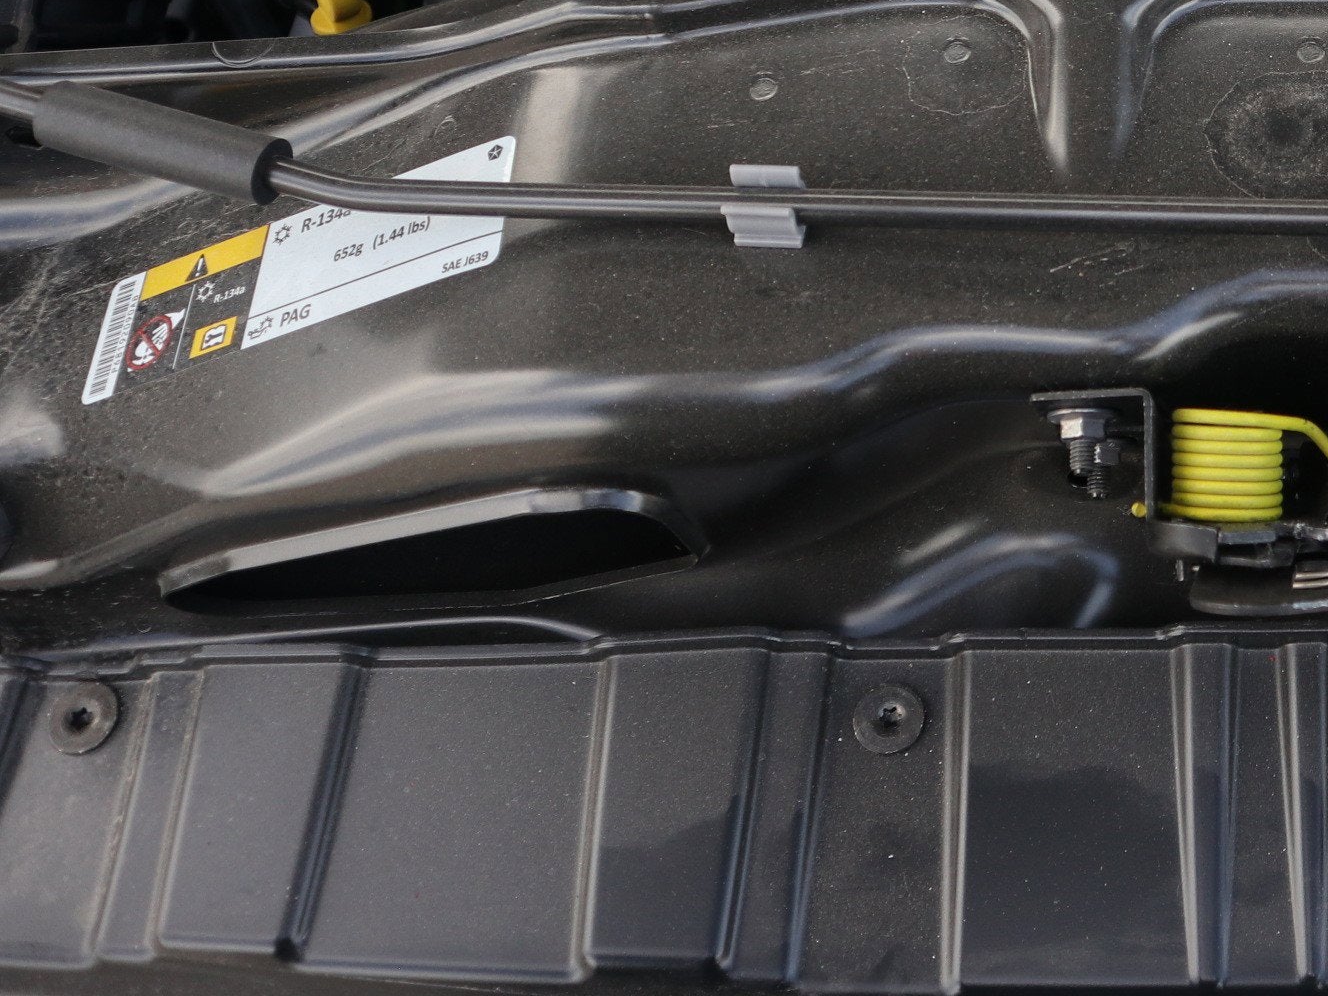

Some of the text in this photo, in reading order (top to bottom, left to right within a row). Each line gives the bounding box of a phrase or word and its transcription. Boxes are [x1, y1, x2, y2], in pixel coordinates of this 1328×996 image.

[300, 207, 352, 234] R-134a
[333, 215, 431, 262] 652g (1.44 lbs)
[441, 250, 489, 274] SAE J639
[212, 285, 246, 304] R-134a
[279, 304, 312, 328] PAG
